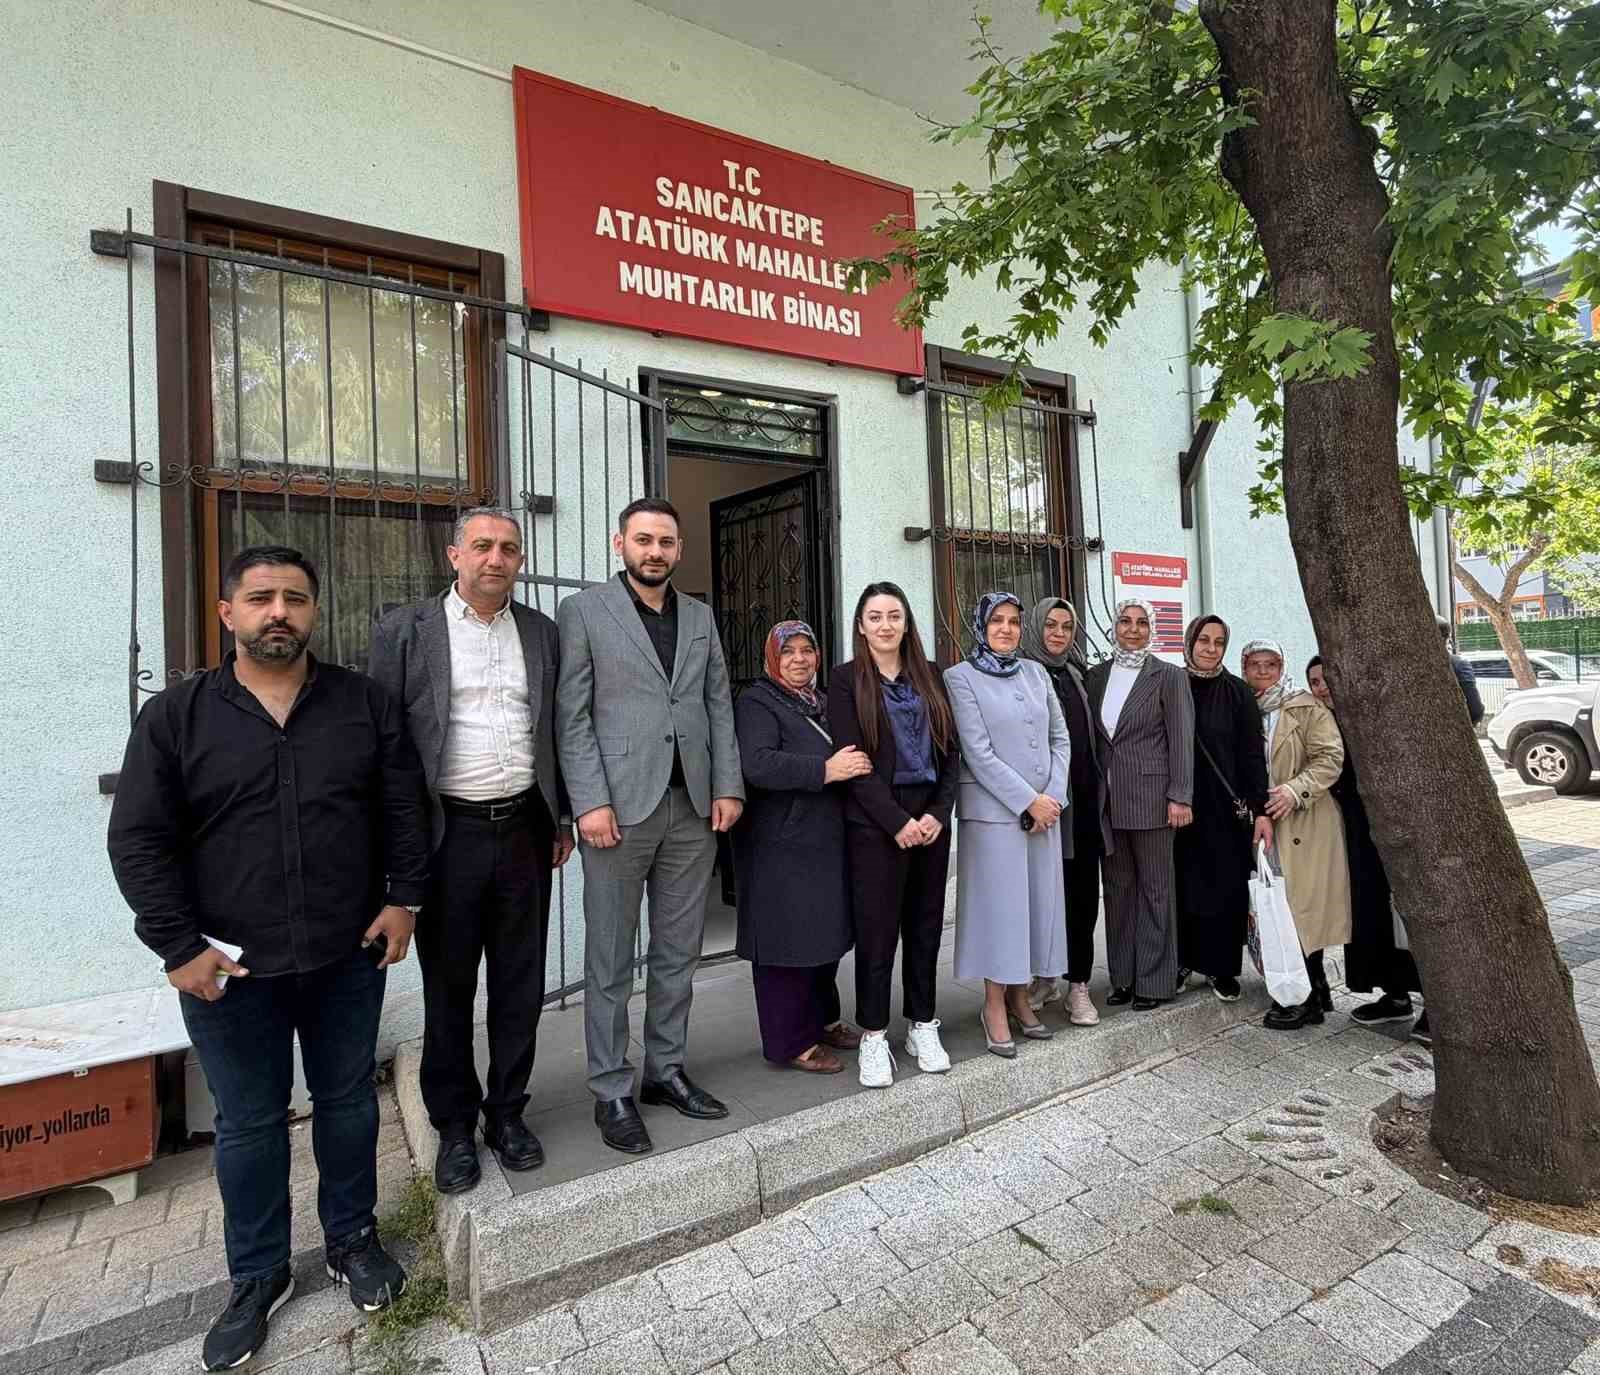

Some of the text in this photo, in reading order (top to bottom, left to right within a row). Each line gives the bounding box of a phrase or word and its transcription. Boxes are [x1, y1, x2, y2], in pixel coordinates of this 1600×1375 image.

[722, 160, 761, 196] T.C
[595, 206, 729, 265] ATATÜRK
[655, 176, 825, 247] SANCAKTEPE
[618, 261, 862, 337] MUHTARLIK BİNASI
